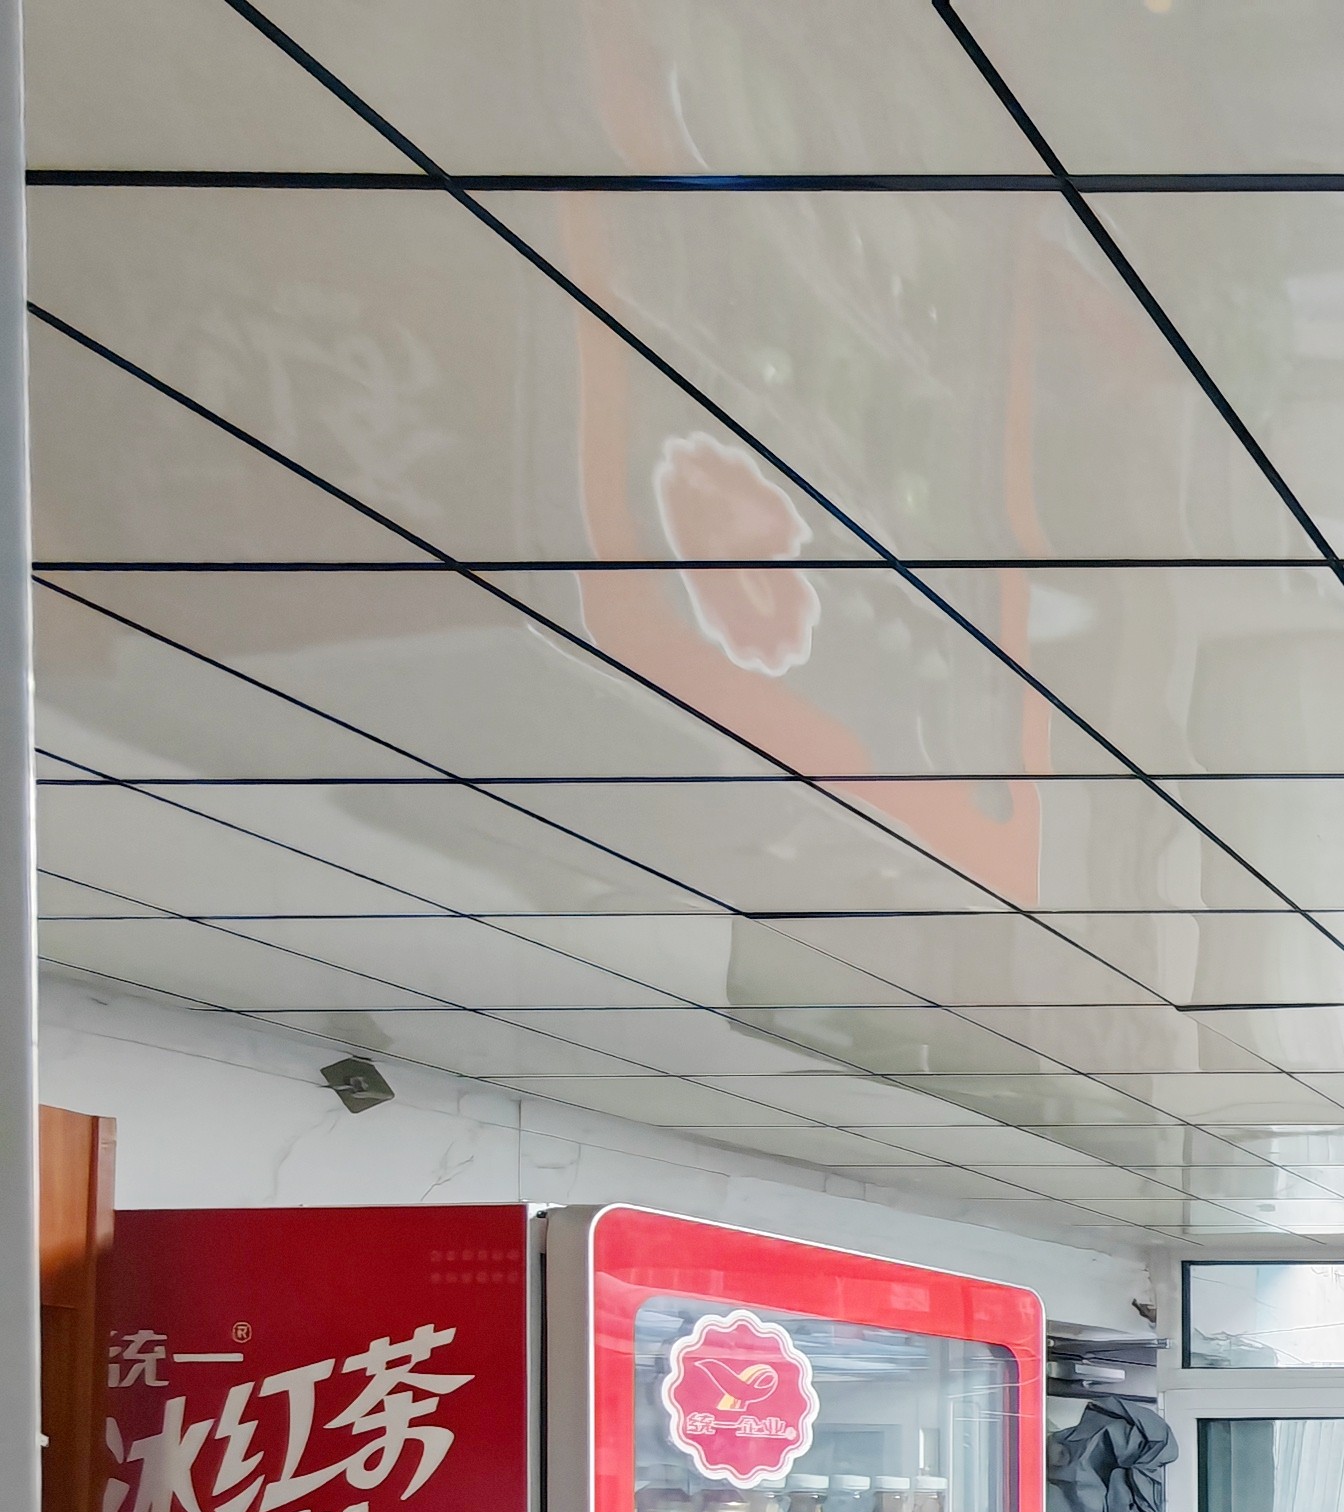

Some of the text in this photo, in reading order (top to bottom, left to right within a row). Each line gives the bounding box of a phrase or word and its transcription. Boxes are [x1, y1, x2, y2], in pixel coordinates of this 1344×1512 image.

[107, 1329, 244, 1388] 统一
[686, 1411, 787, 1439] 统一企业
